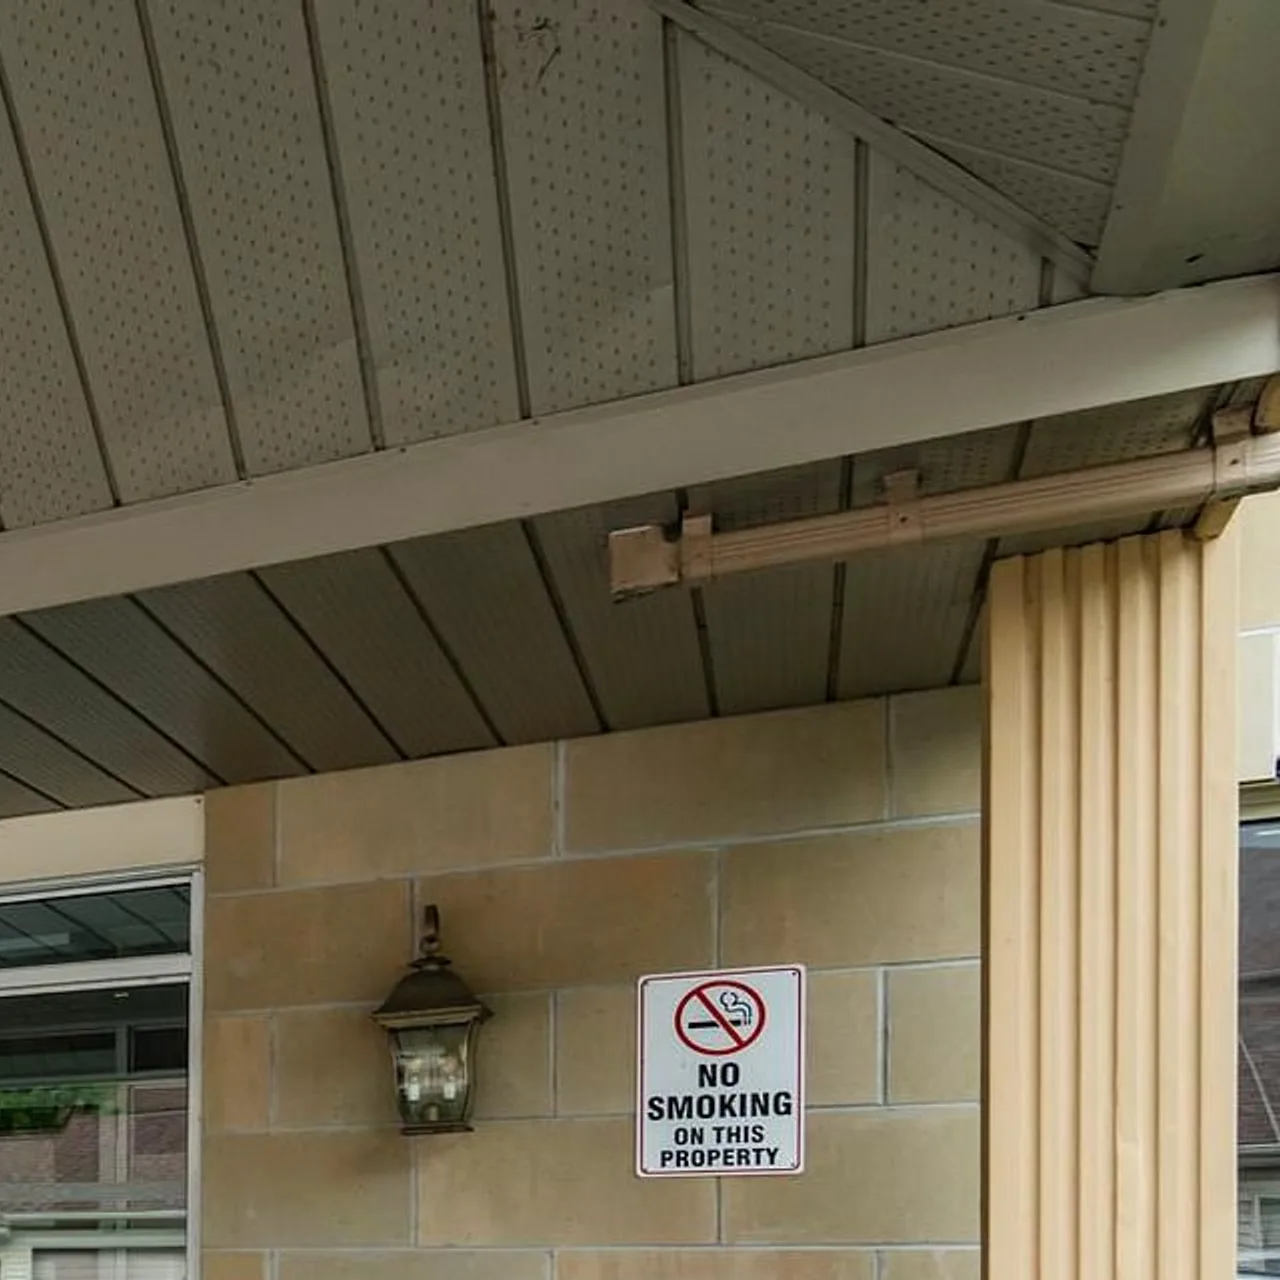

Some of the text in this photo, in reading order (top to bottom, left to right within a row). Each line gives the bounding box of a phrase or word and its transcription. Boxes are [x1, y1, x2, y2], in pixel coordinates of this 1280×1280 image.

[698, 1062, 740, 1088] NO
[647, 1091, 793, 1121] SMOKING
[674, 1125, 765, 1145] ON THIS
[660, 1148, 779, 1168] PROPERTY
